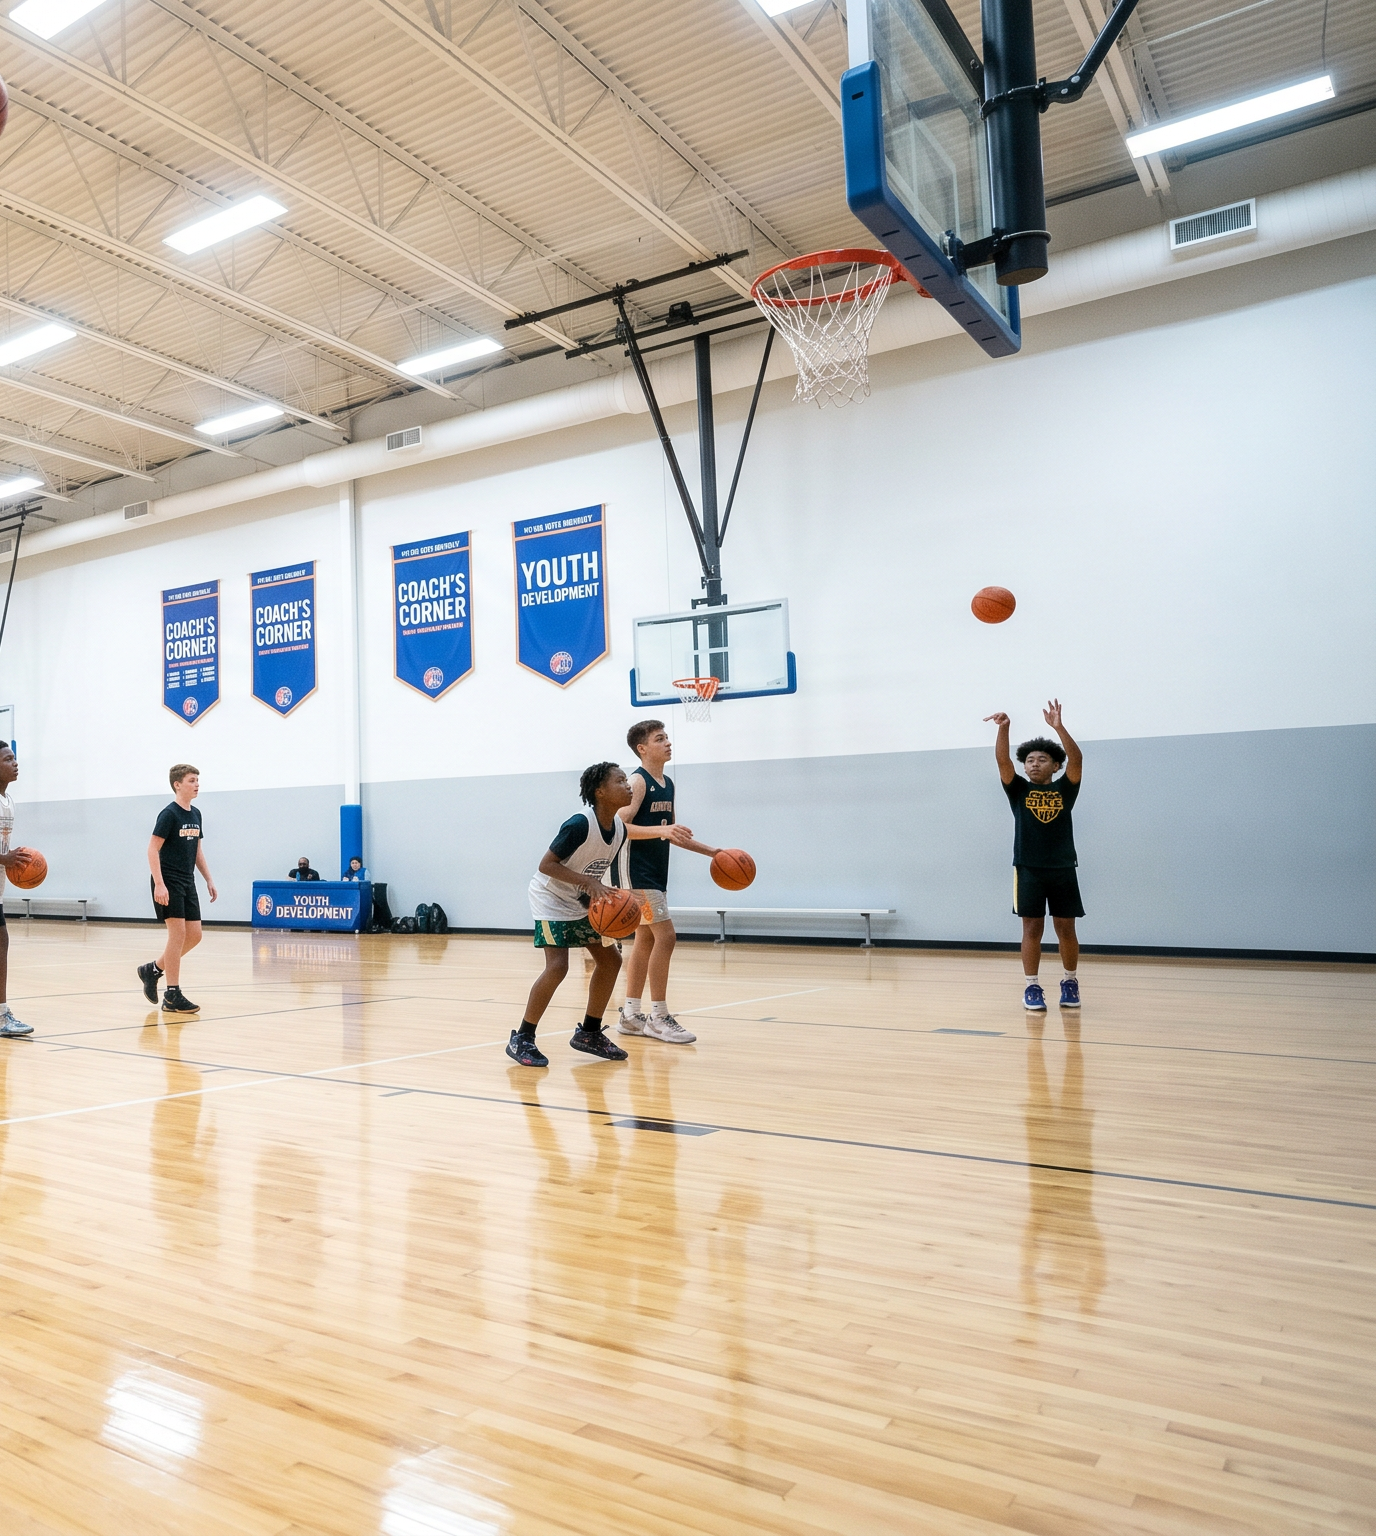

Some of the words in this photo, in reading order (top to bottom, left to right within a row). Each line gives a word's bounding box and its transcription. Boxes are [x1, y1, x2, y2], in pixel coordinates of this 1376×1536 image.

[521, 551, 598, 590] YOUTH
[398, 573, 466, 603] COACH'S
[521, 582, 600, 607] DEVELOPMENT
[255, 599, 311, 626] COACH'S
[399, 597, 466, 626] CORNER
[166, 616, 215, 641] COACH'S
[256, 620, 312, 647] CORNER
[166, 636, 216, 661] CORNER
[276, 906, 353, 920] DEVELOPMENT
[293, 895, 329, 906] YOUTH
